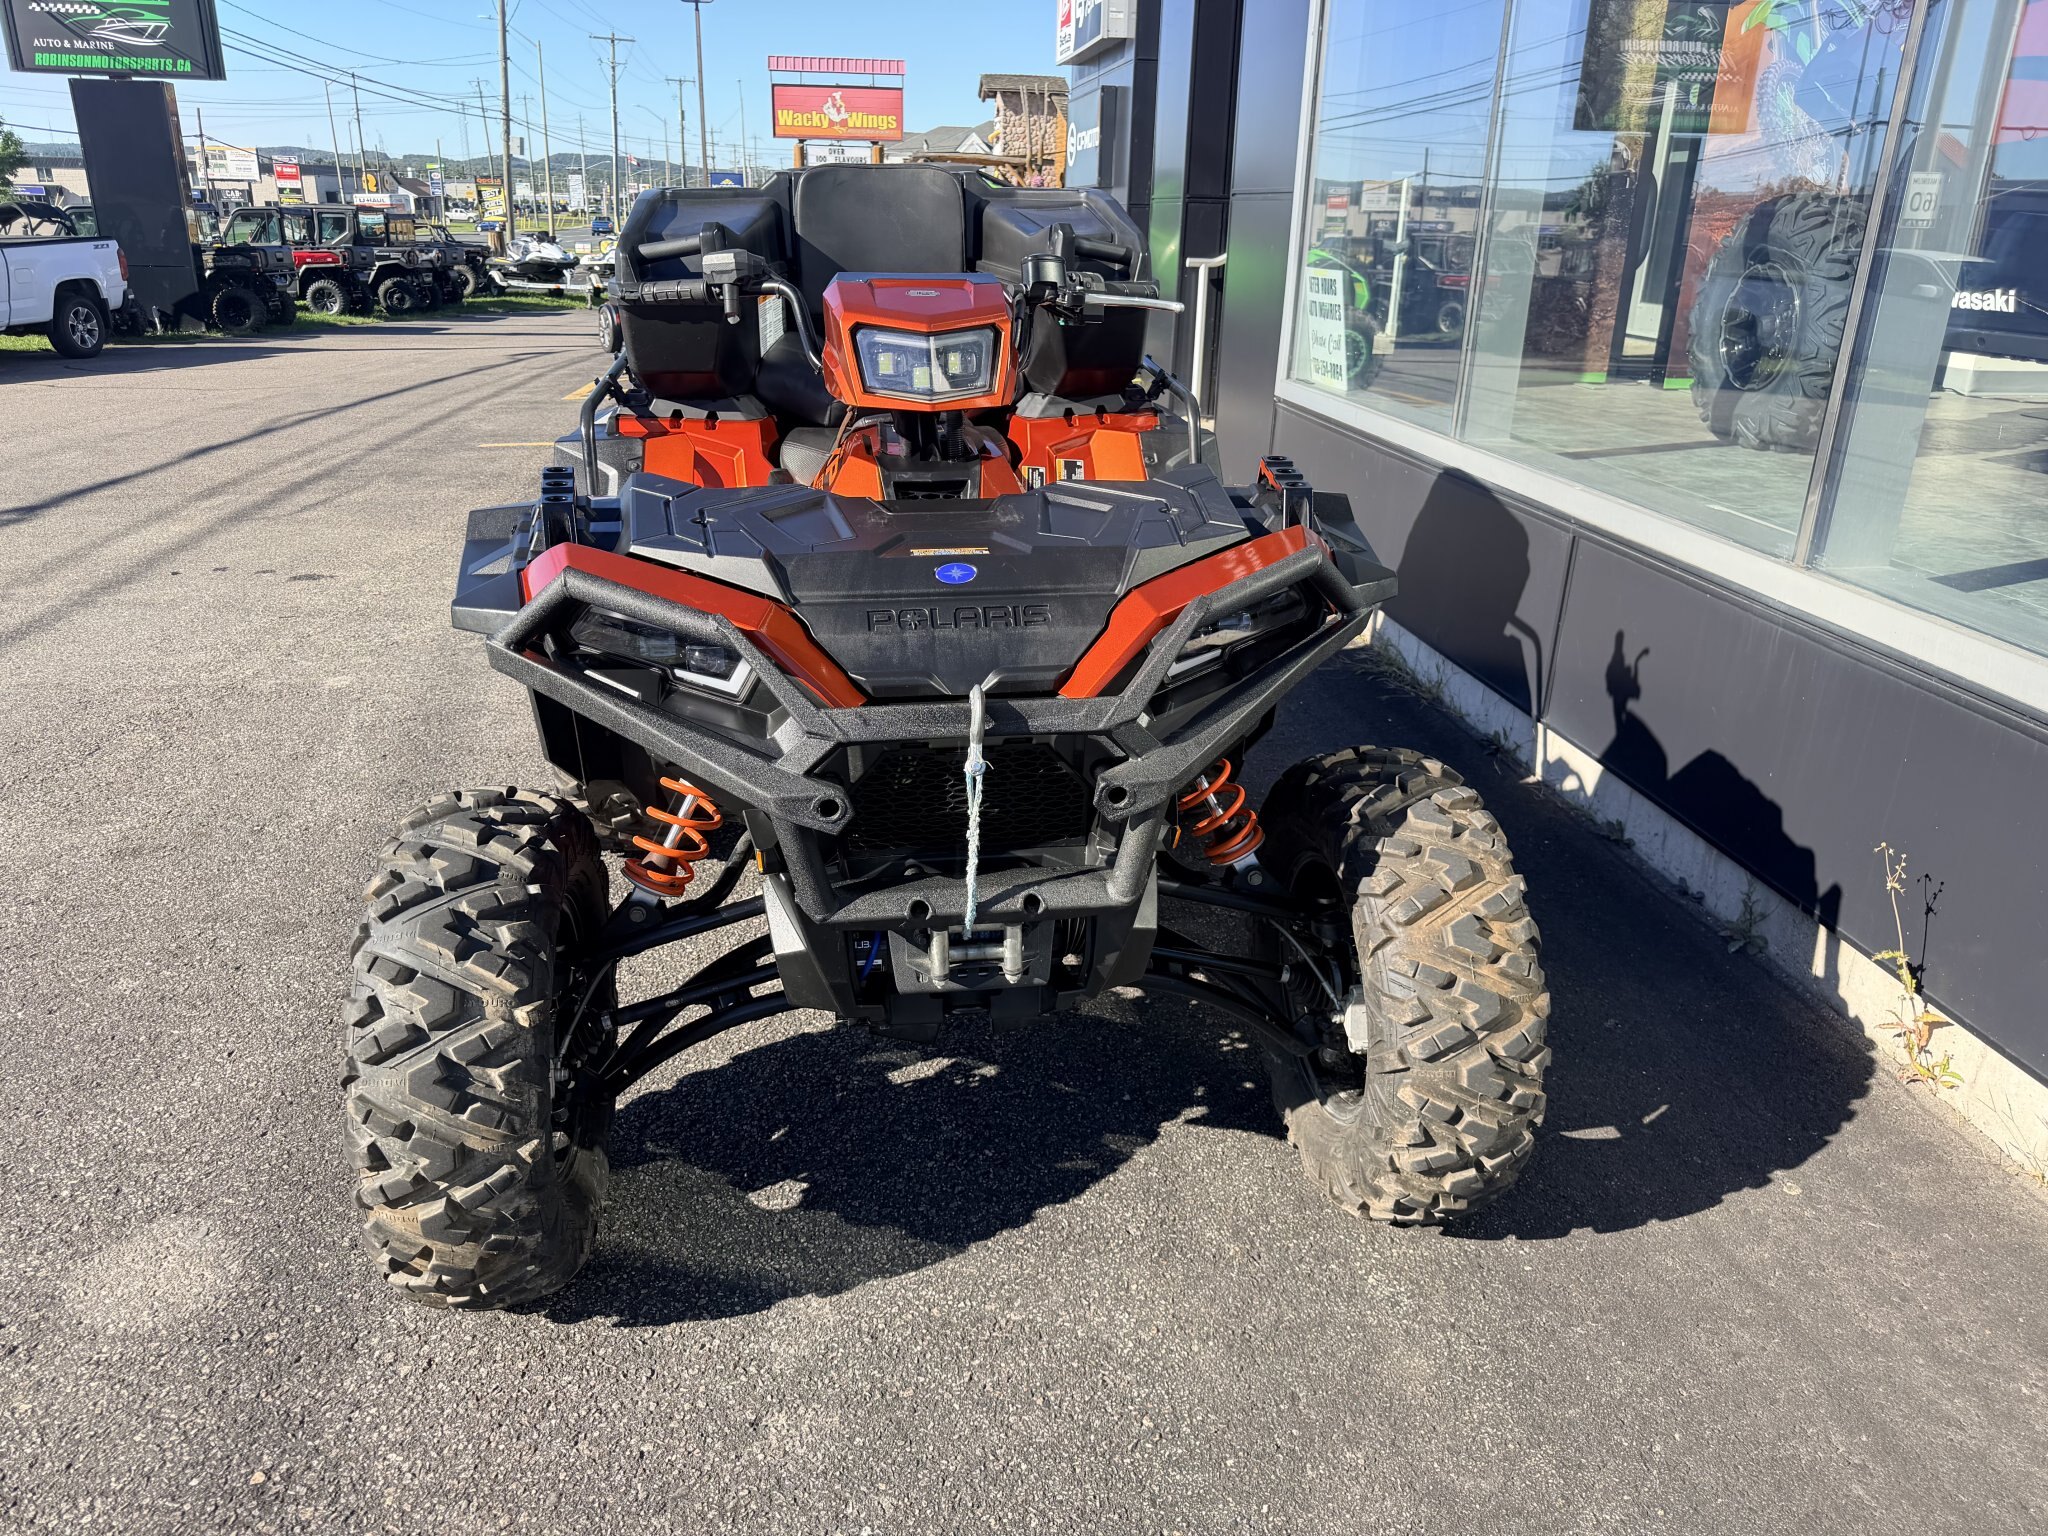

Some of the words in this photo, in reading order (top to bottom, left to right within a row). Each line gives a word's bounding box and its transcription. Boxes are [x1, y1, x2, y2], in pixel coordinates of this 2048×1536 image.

[33, 38, 62, 49] AUTO
[63, 40, 71, 49] &
[73, 40, 115, 50] MARINE
[34, 52, 191, 72] ROBINSONMOTORSPORTS.CA
[777, 109, 829, 129] Wacky
[847, 112, 897, 130] Wings
[815, 155, 827, 163] 100
[834, 156, 867, 164] FLAVOURS
[828, 147, 845, 156] OVER
[1320, 277, 1337, 296] HOURS
[866, 603, 1051, 633] POLARIS
